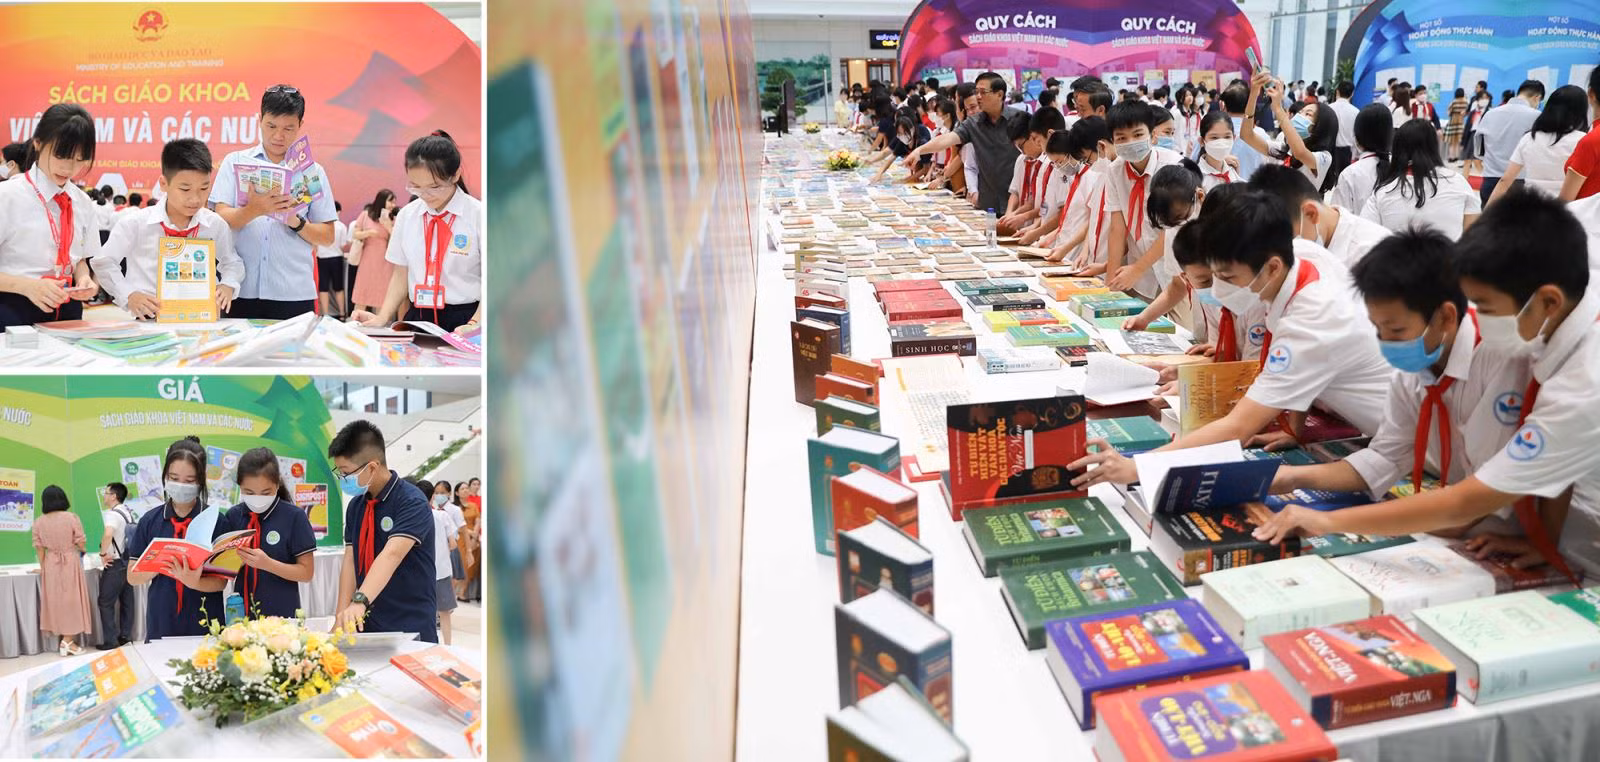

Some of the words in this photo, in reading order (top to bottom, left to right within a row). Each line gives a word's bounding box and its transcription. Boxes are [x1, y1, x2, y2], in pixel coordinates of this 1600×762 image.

[975, 15, 1009, 31] QUY
[1012, 10, 1056, 28] CÁCH
[1121, 17, 1154, 32] QUY
[1156, 15, 1197, 34] CÁCH
[48, 80, 108, 104] SÁCH
[114, 80, 172, 104] GIÁO
[179, 81, 250, 102] KHOA
[123, 111, 152, 144] VÀ
[162, 110, 212, 144] CÁC
[930, 344, 950, 352] HỌC
[158, 376, 204, 404] GIÁ
[4, 406, 32, 426] NƯỚC
[100, 412, 123, 429] SÁCH
[124, 410, 145, 426] GIÁO
[146, 412, 168, 426] KHOA
[170, 410, 187, 427] VIỆT
[189, 413, 206, 426] NAM
[206, 412, 218, 426] VÀ
[218, 414, 234, 428] CÁC
[234, 416, 253, 431] NƯỚC
[1304, 631, 1357, 684] VIỆT-NGA
[1390, 690, 1432, 708] VIỆT-NGA
